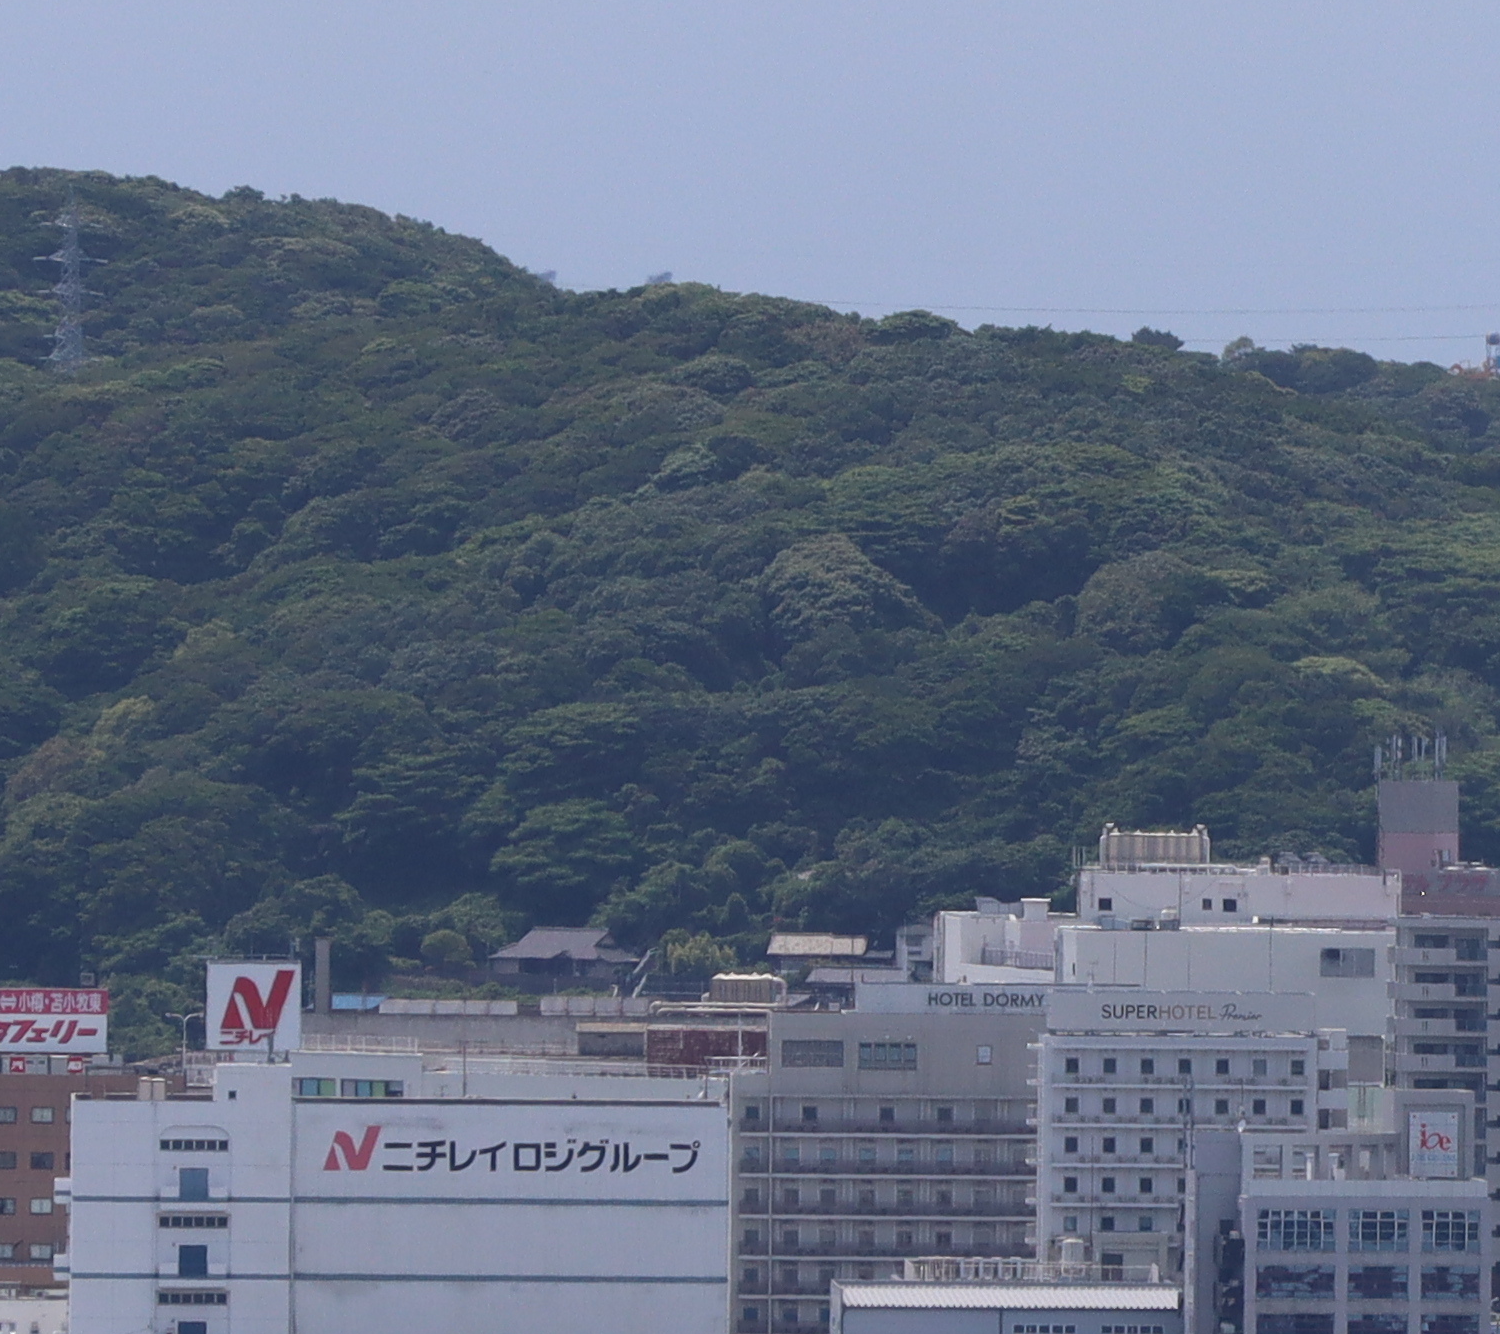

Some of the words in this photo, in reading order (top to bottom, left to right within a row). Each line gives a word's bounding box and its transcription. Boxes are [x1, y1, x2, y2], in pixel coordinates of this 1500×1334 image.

[927, 992, 976, 1007] HOTEL
[982, 992, 1045, 1008] DORMY
[1101, 1003, 1218, 1020] SUPERHOTEL
[382, 1138, 701, 1174] ニチレイロジグループ
